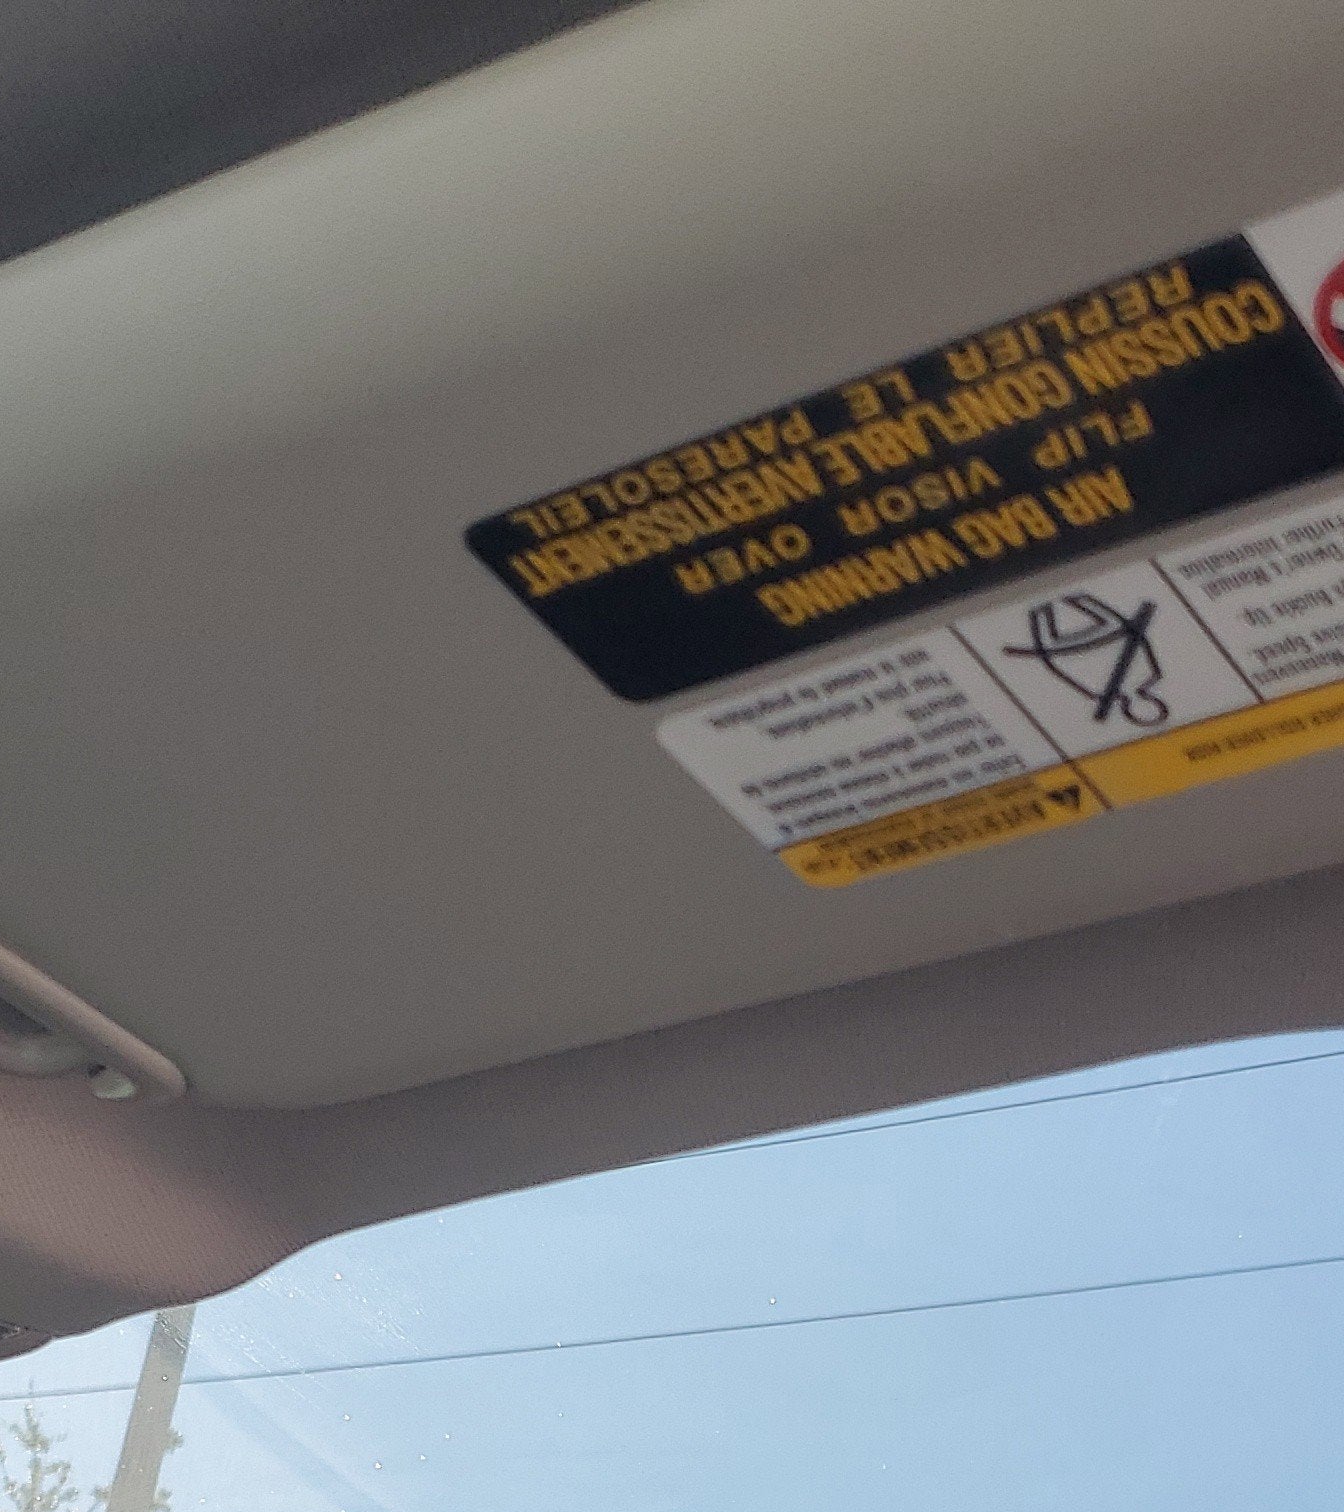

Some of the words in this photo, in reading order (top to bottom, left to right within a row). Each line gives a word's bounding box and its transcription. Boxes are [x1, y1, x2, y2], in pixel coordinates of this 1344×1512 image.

[934, 260, 1202, 384] REPLIER
[1055, 276, 1292, 398] COUSSIN
[803, 355, 1082, 488] GONFLABLE
[831, 367, 923, 422] LE
[1017, 396, 1164, 474] FLIP
[502, 404, 819, 543] PARESOLEIL
[826, 451, 1008, 539] VISOR
[1039, 461, 1147, 532] AIR
[497, 449, 836, 599] AVERTISSEMENT
[661, 518, 823, 598] OVER
[944, 490, 1065, 564] BAG
[748, 523, 975, 631] WARNING
[1198, 565, 1273, 602] Manual
[1267, 587, 1337, 623] Buckle
